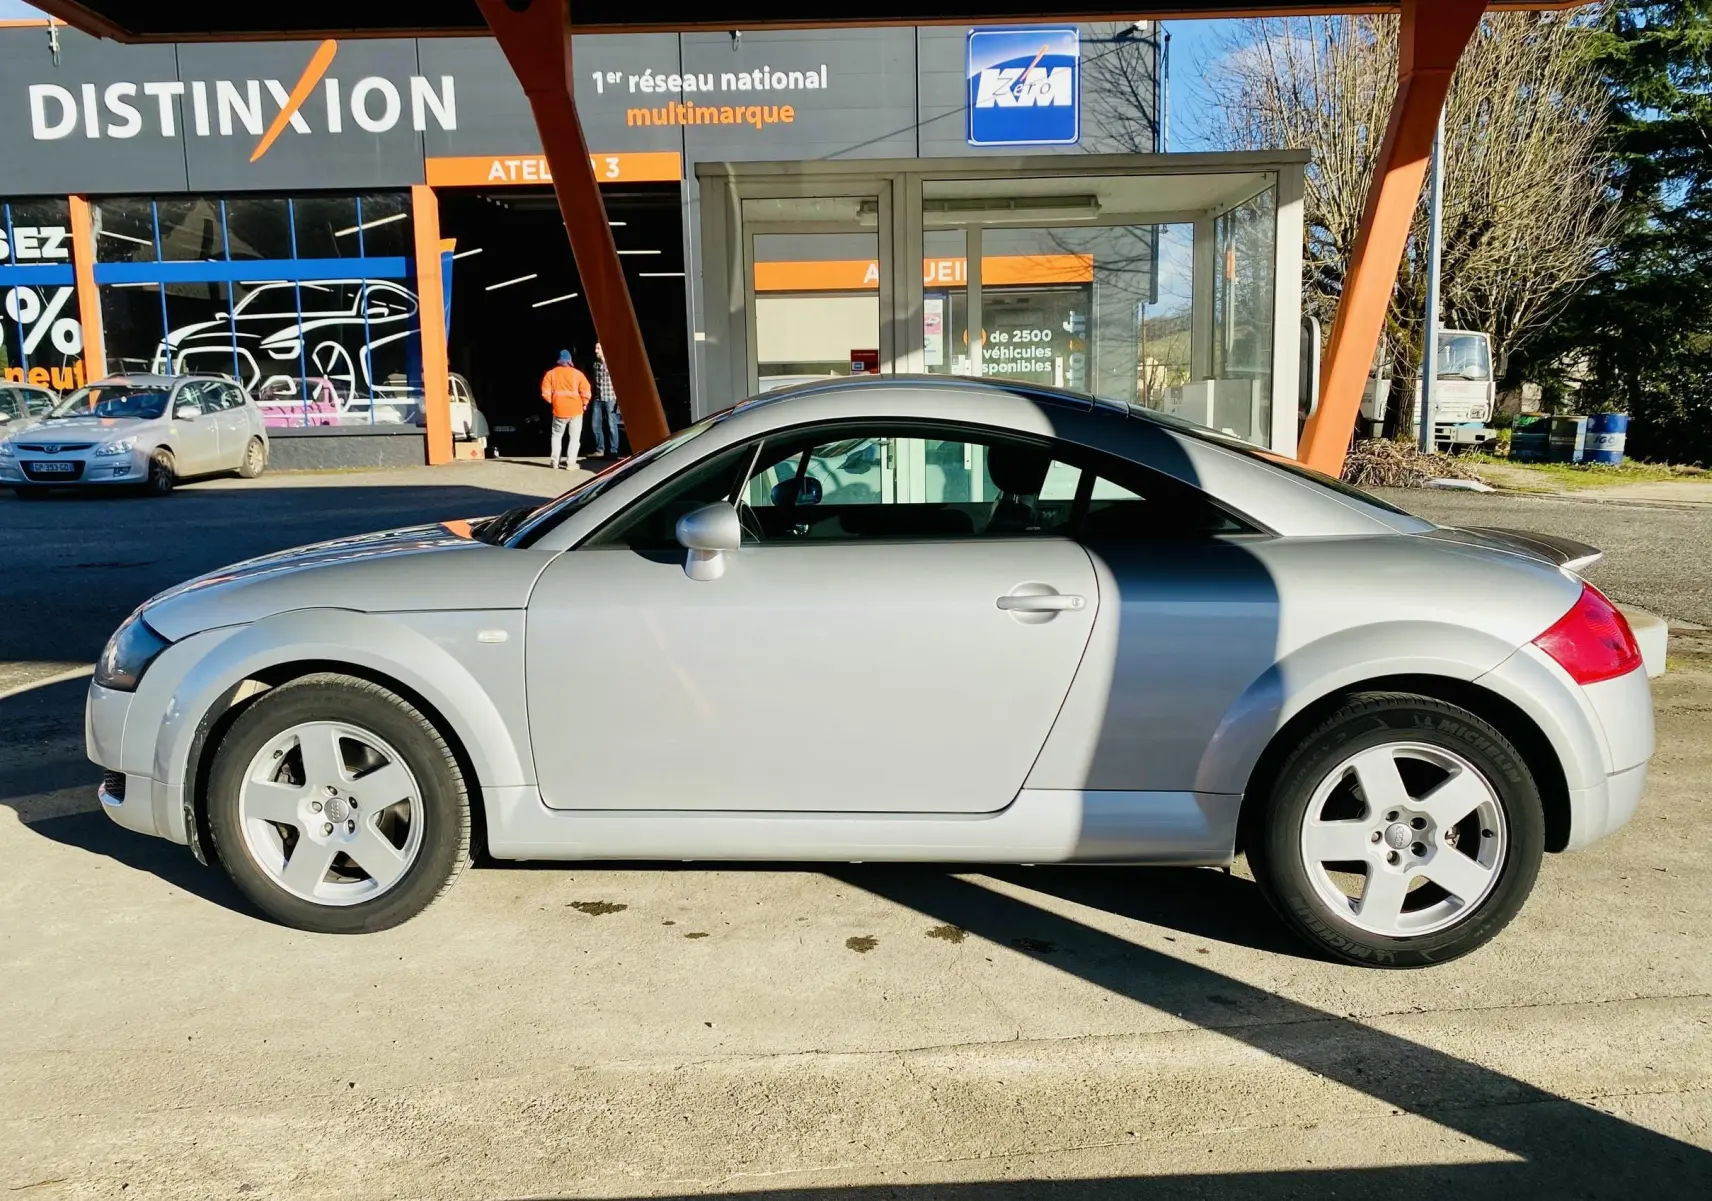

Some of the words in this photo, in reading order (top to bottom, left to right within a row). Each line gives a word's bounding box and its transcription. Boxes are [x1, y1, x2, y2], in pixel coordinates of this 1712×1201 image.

[628, 68, 714, 93] réseau
[720, 64, 828, 91] national
[29, 39, 458, 163] DISTINXION
[626, 101, 796, 129] multimarque
[488, 158, 596, 181] ATEL
[605, 157, 620, 179] 3
[989, 330, 1009, 343] de
[1012, 329, 1053, 342] 2500
[983, 345, 1052, 359] véhicules
[982, 360, 1052, 375] sponibles
[1438, 718, 1521, 784] MICHELIN
[1288, 896, 1372, 959] MICHELIN
